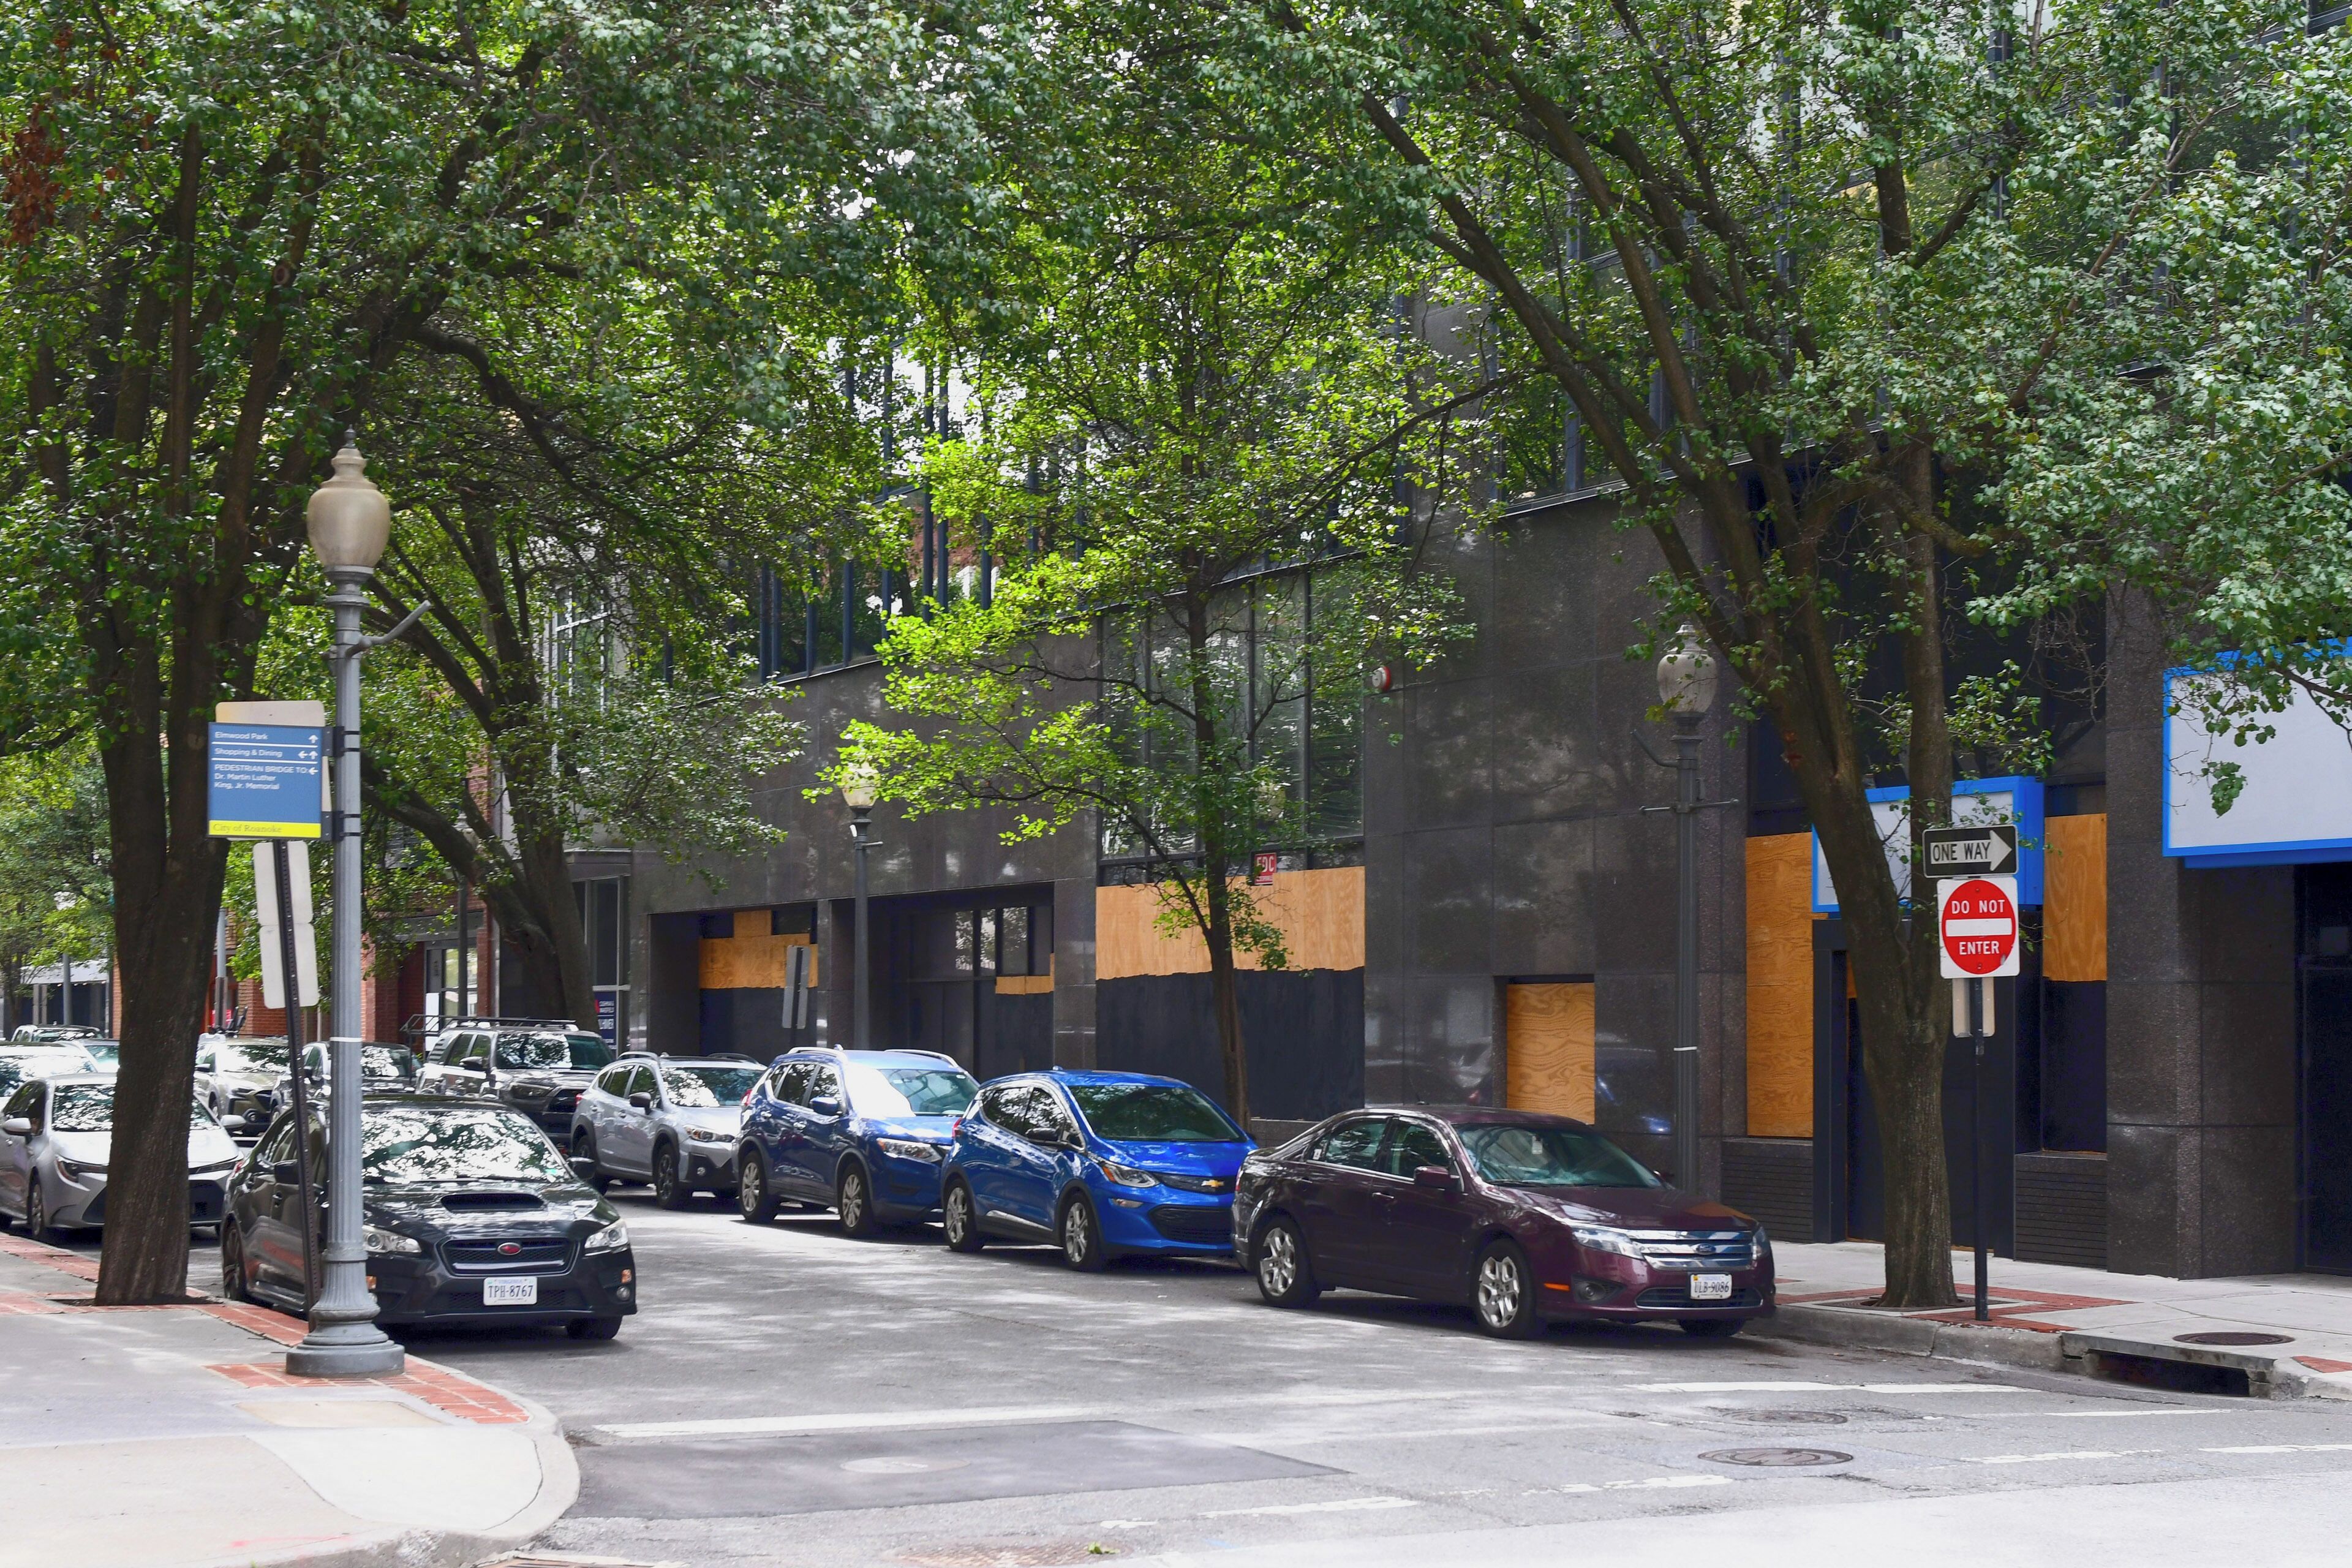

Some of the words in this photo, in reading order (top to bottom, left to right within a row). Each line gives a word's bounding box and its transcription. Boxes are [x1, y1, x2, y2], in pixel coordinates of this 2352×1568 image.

[214, 731, 250, 740] Elmwood
[251, 732, 268, 741] Park
[214, 748, 250, 757] Shopping
[213, 823, 230, 833] City
[1932, 843, 1958, 862] ONE
[1964, 842, 1991, 860] WAY
[1951, 900, 1970, 914] DO
[1979, 900, 2005, 913] NOT
[1959, 941, 2000, 956] ENTER
[488, 1285, 533, 1298] TPH-8767
